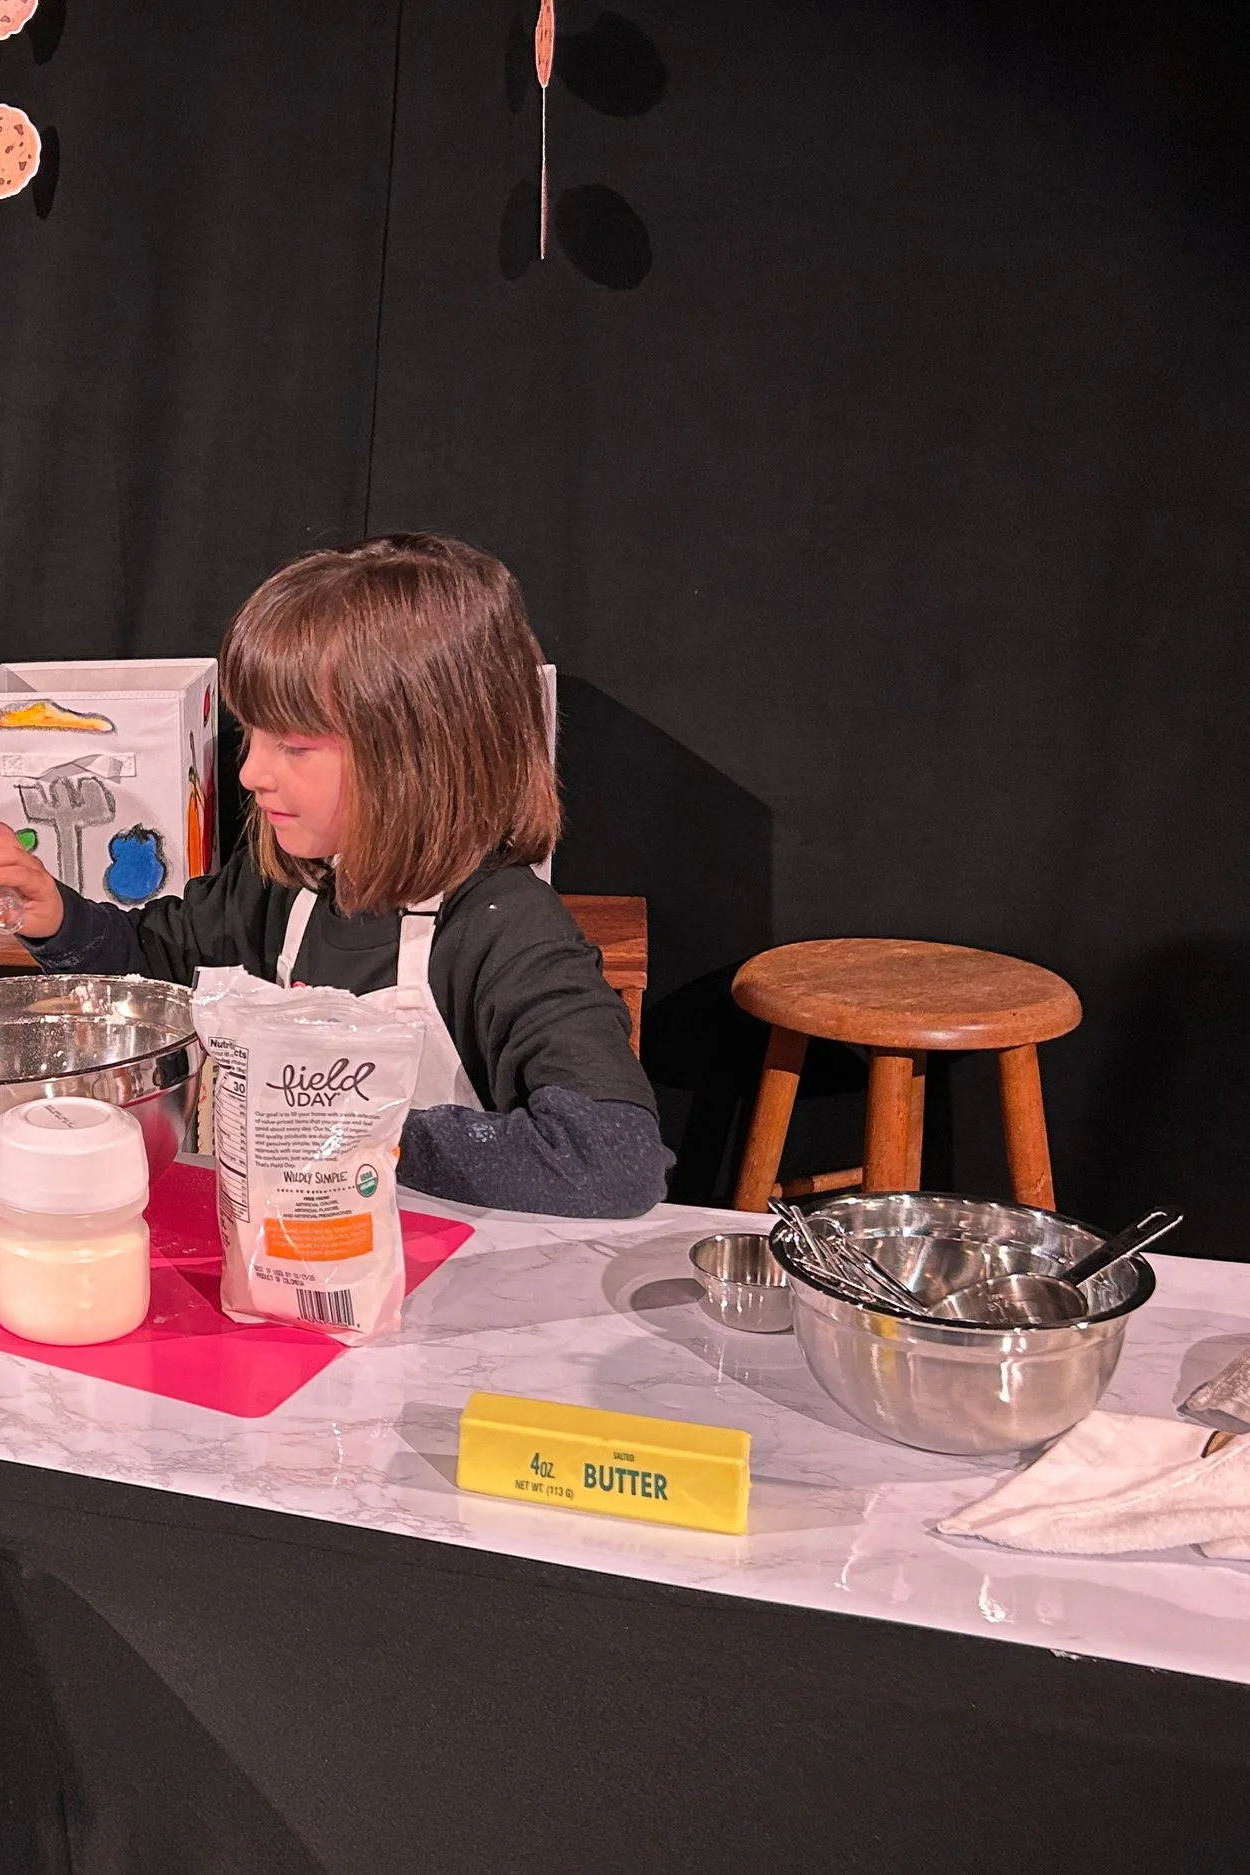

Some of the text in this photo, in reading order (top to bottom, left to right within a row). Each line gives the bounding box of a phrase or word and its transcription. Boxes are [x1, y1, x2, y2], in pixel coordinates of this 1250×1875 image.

[233, 1081, 246, 1094] 30
[265, 1057, 376, 1107] field
[297, 1092, 337, 1107] DAY
[515, 1480, 529, 1490] NET
[583, 1463, 668, 1500] BUTTER
